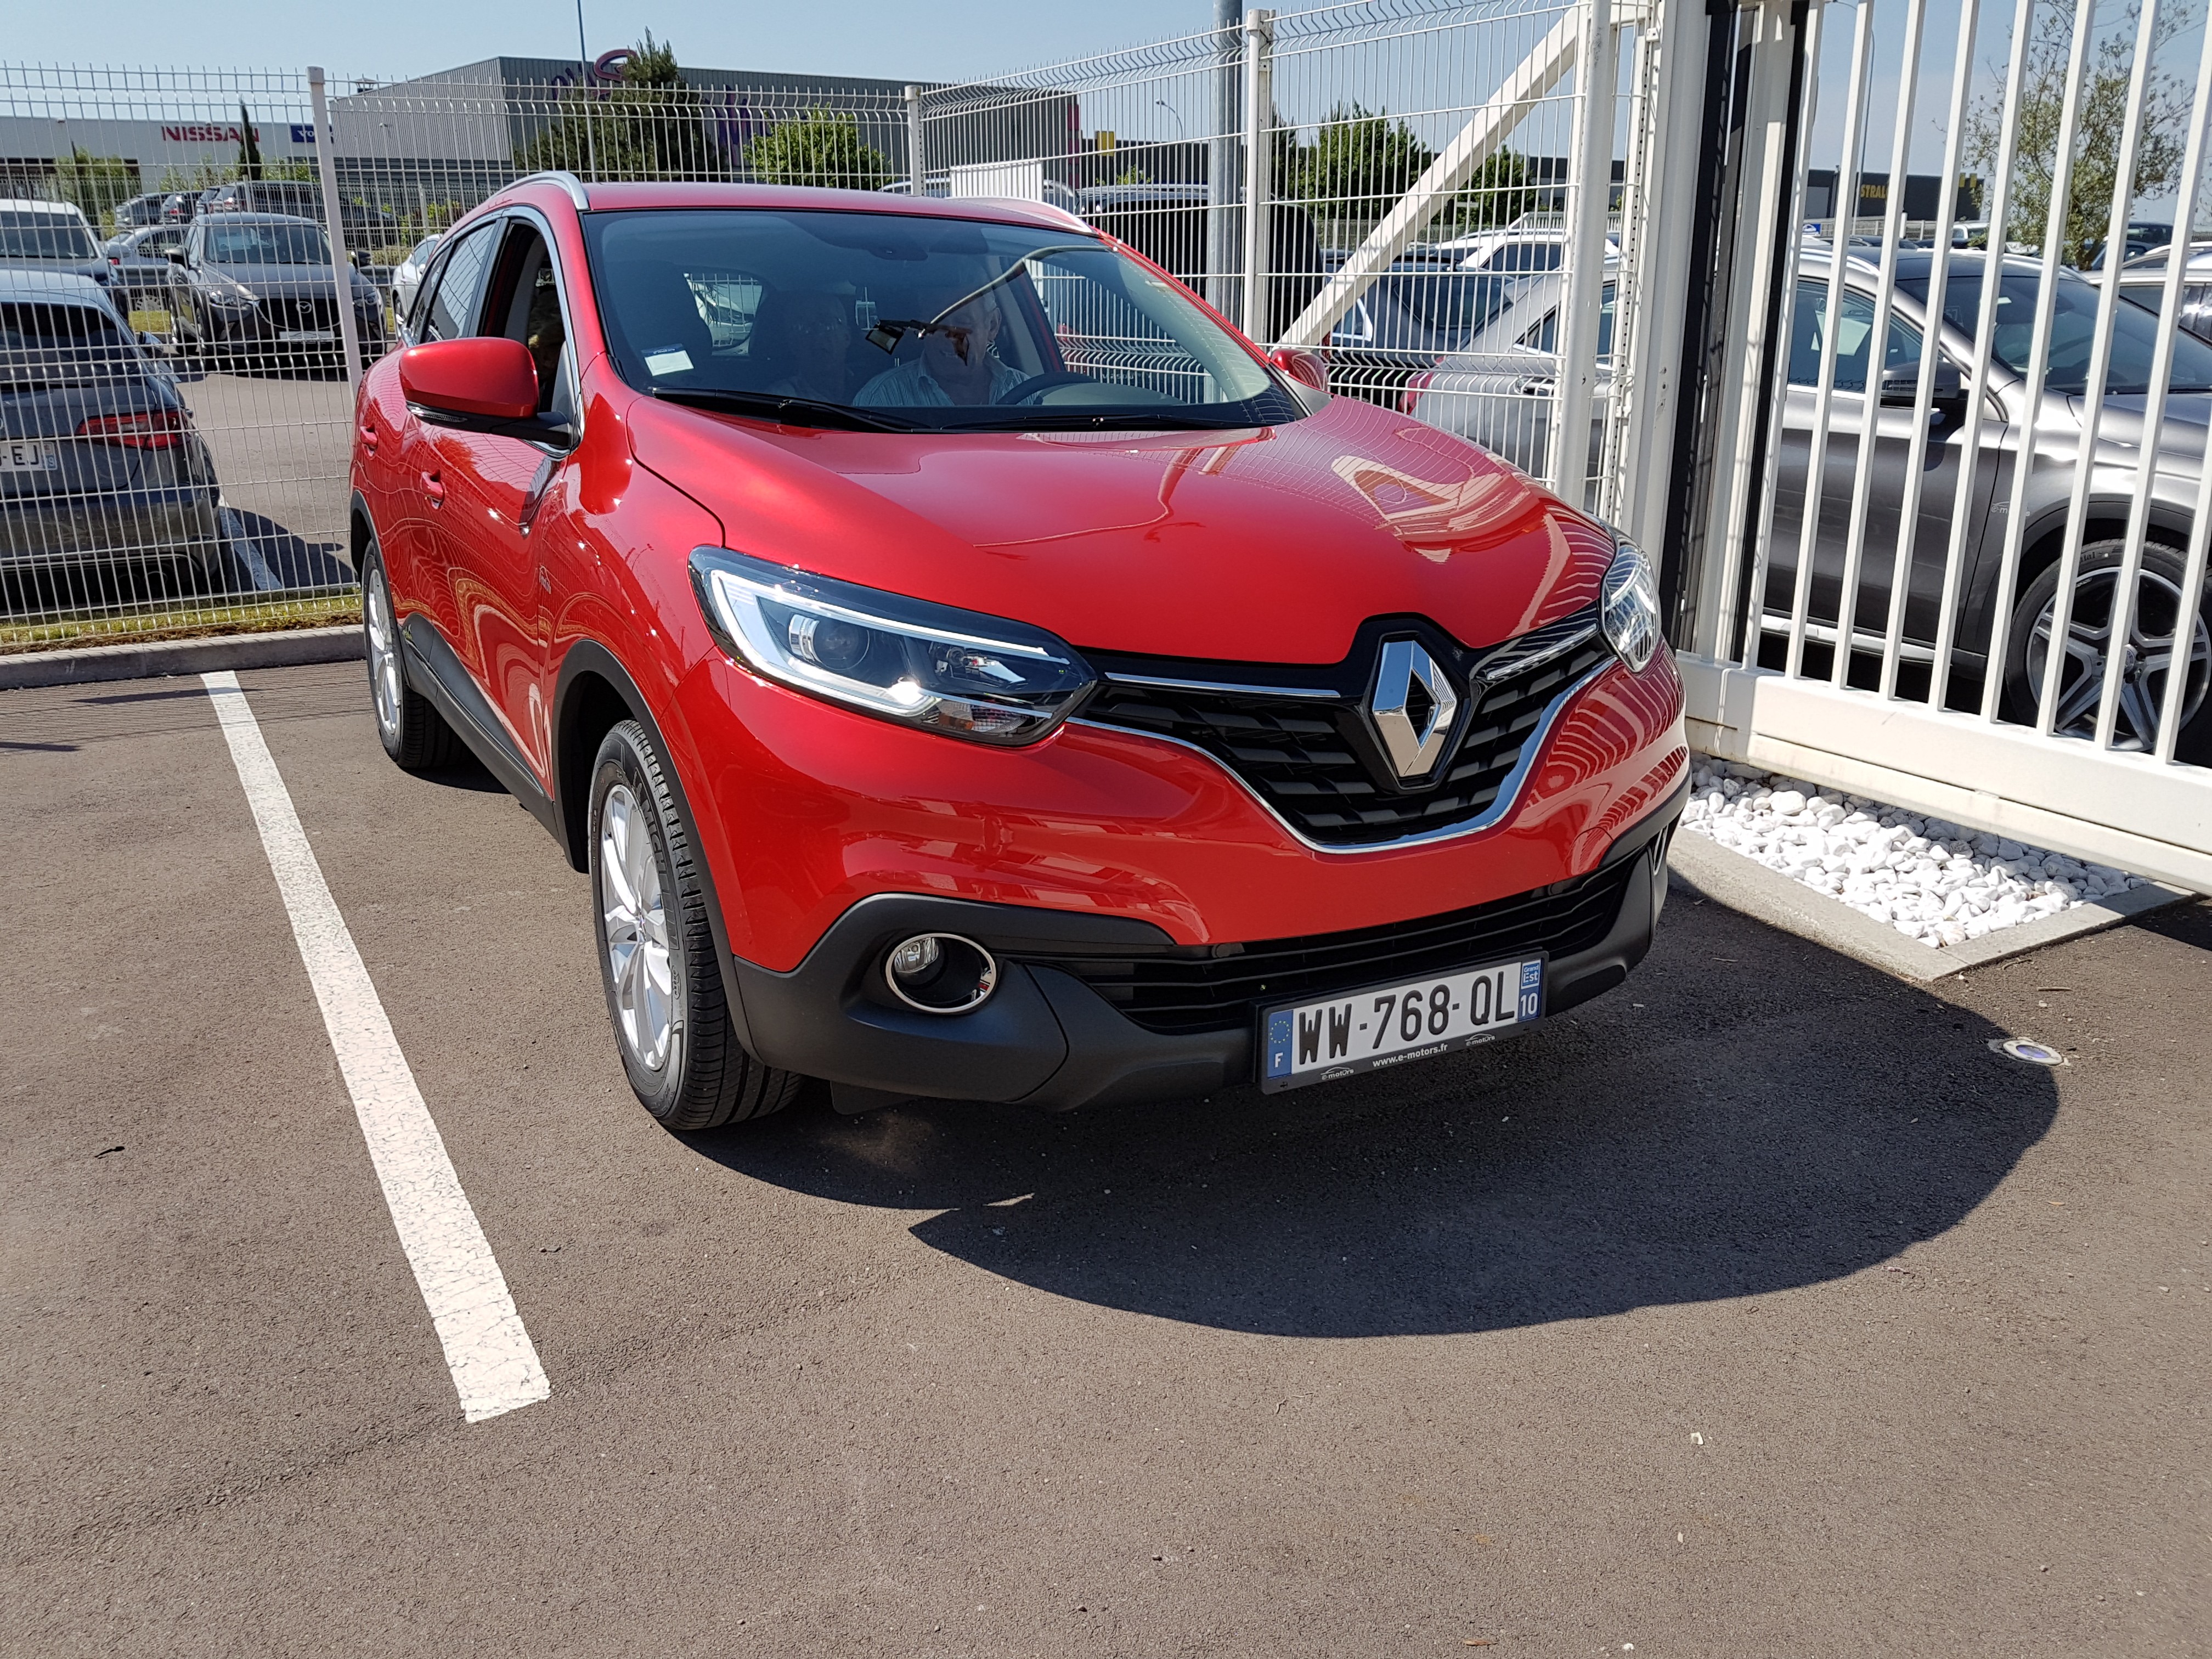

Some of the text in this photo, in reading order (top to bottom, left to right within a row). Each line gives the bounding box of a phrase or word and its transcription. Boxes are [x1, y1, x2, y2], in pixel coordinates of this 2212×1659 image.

[0, 445, 40, 466] -EJ
[1523, 971, 1538, 983] Est
[1524, 964, 1539, 973] Grand
[1520, 992, 1538, 1017] 10
[1274, 1052, 1283, 1068] F
[1372, 1043, 1448, 1067] www.e-motors.fr
